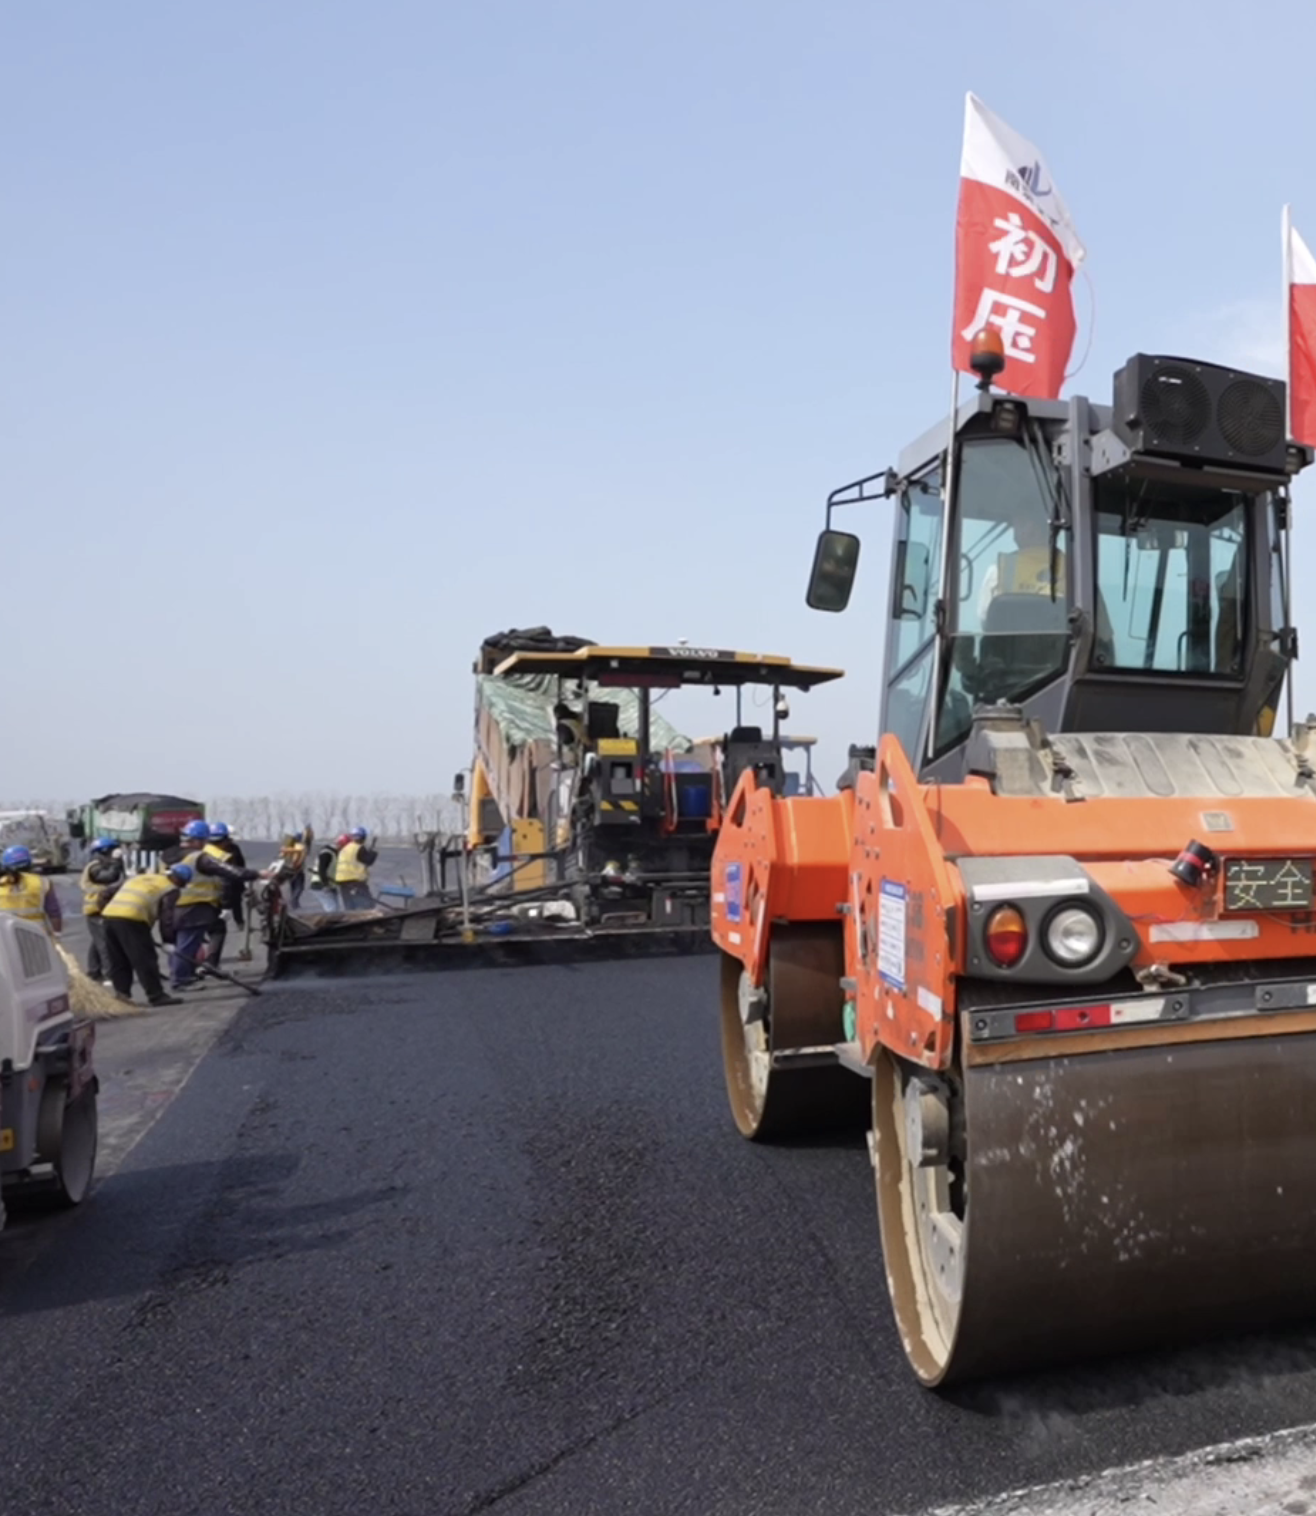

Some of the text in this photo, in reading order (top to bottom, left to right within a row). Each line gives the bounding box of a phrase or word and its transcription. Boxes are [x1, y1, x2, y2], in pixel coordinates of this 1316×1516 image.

[961, 212, 1057, 364] 初压
[668, 648, 719, 659] VOLVO
[1226, 860, 1311, 909] 安全
